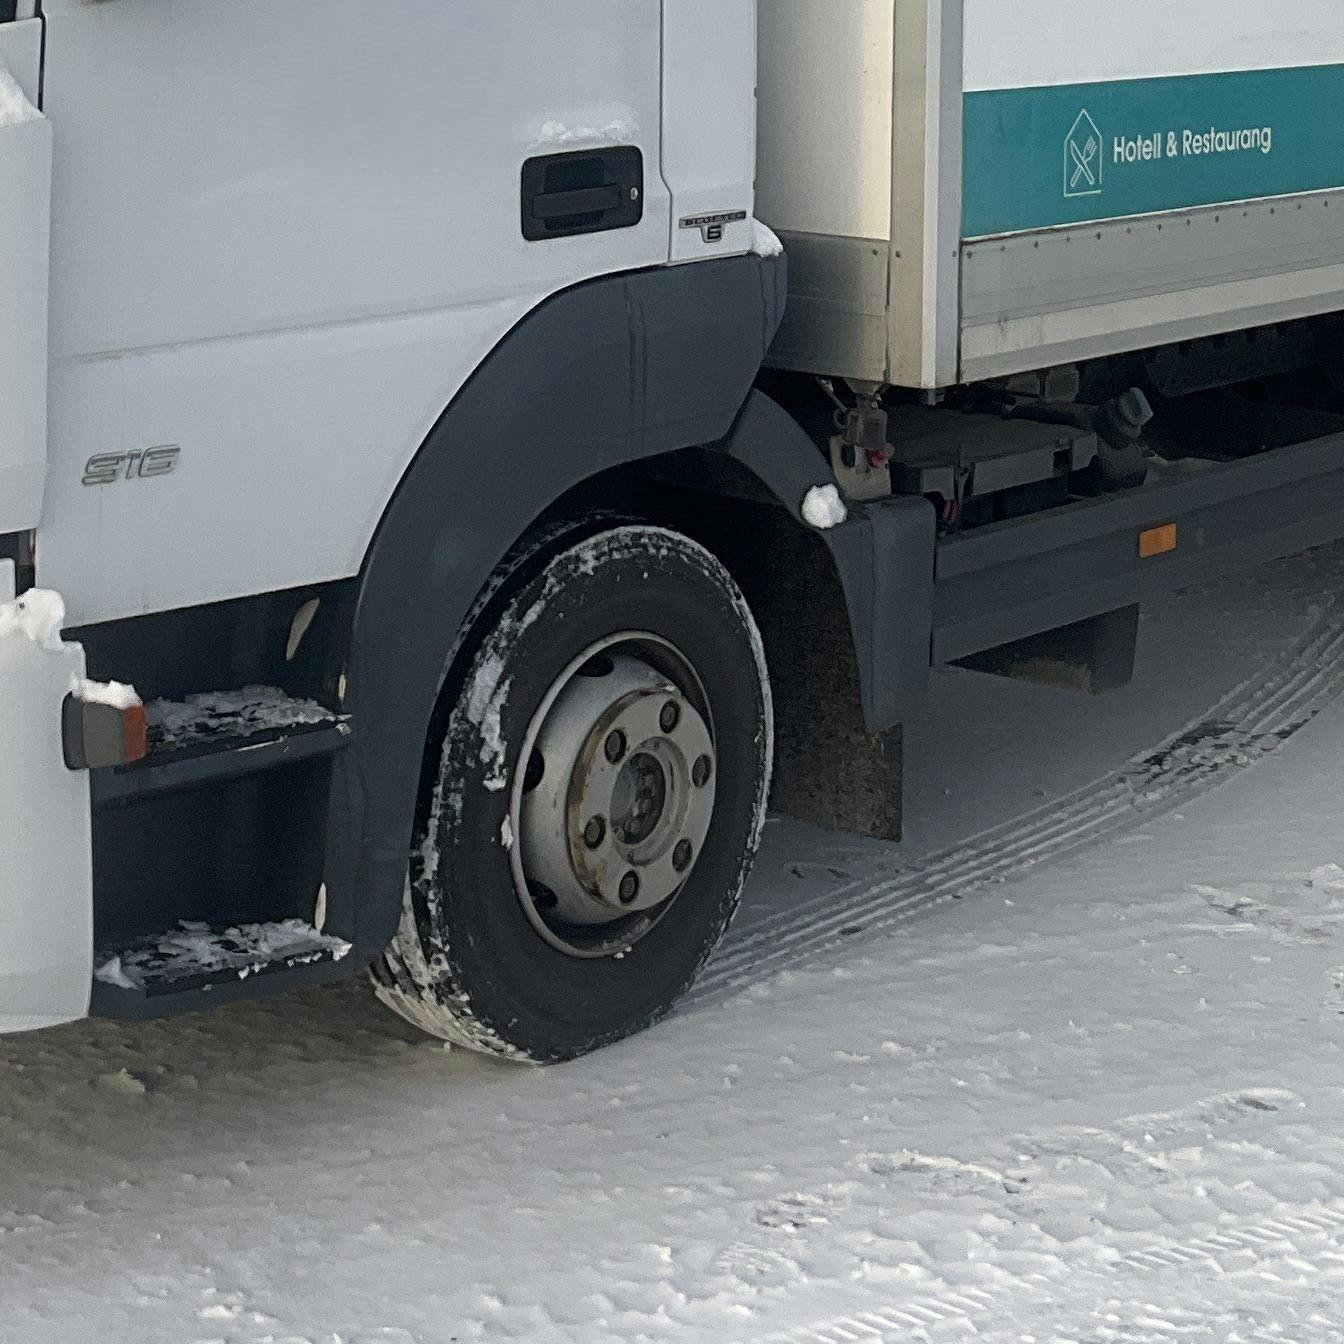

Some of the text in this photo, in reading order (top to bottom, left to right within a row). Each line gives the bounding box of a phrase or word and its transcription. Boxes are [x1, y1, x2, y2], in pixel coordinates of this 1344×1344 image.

[1113, 127, 1272, 163] Hotell & Restaurang
[707, 225, 722, 239] 6
